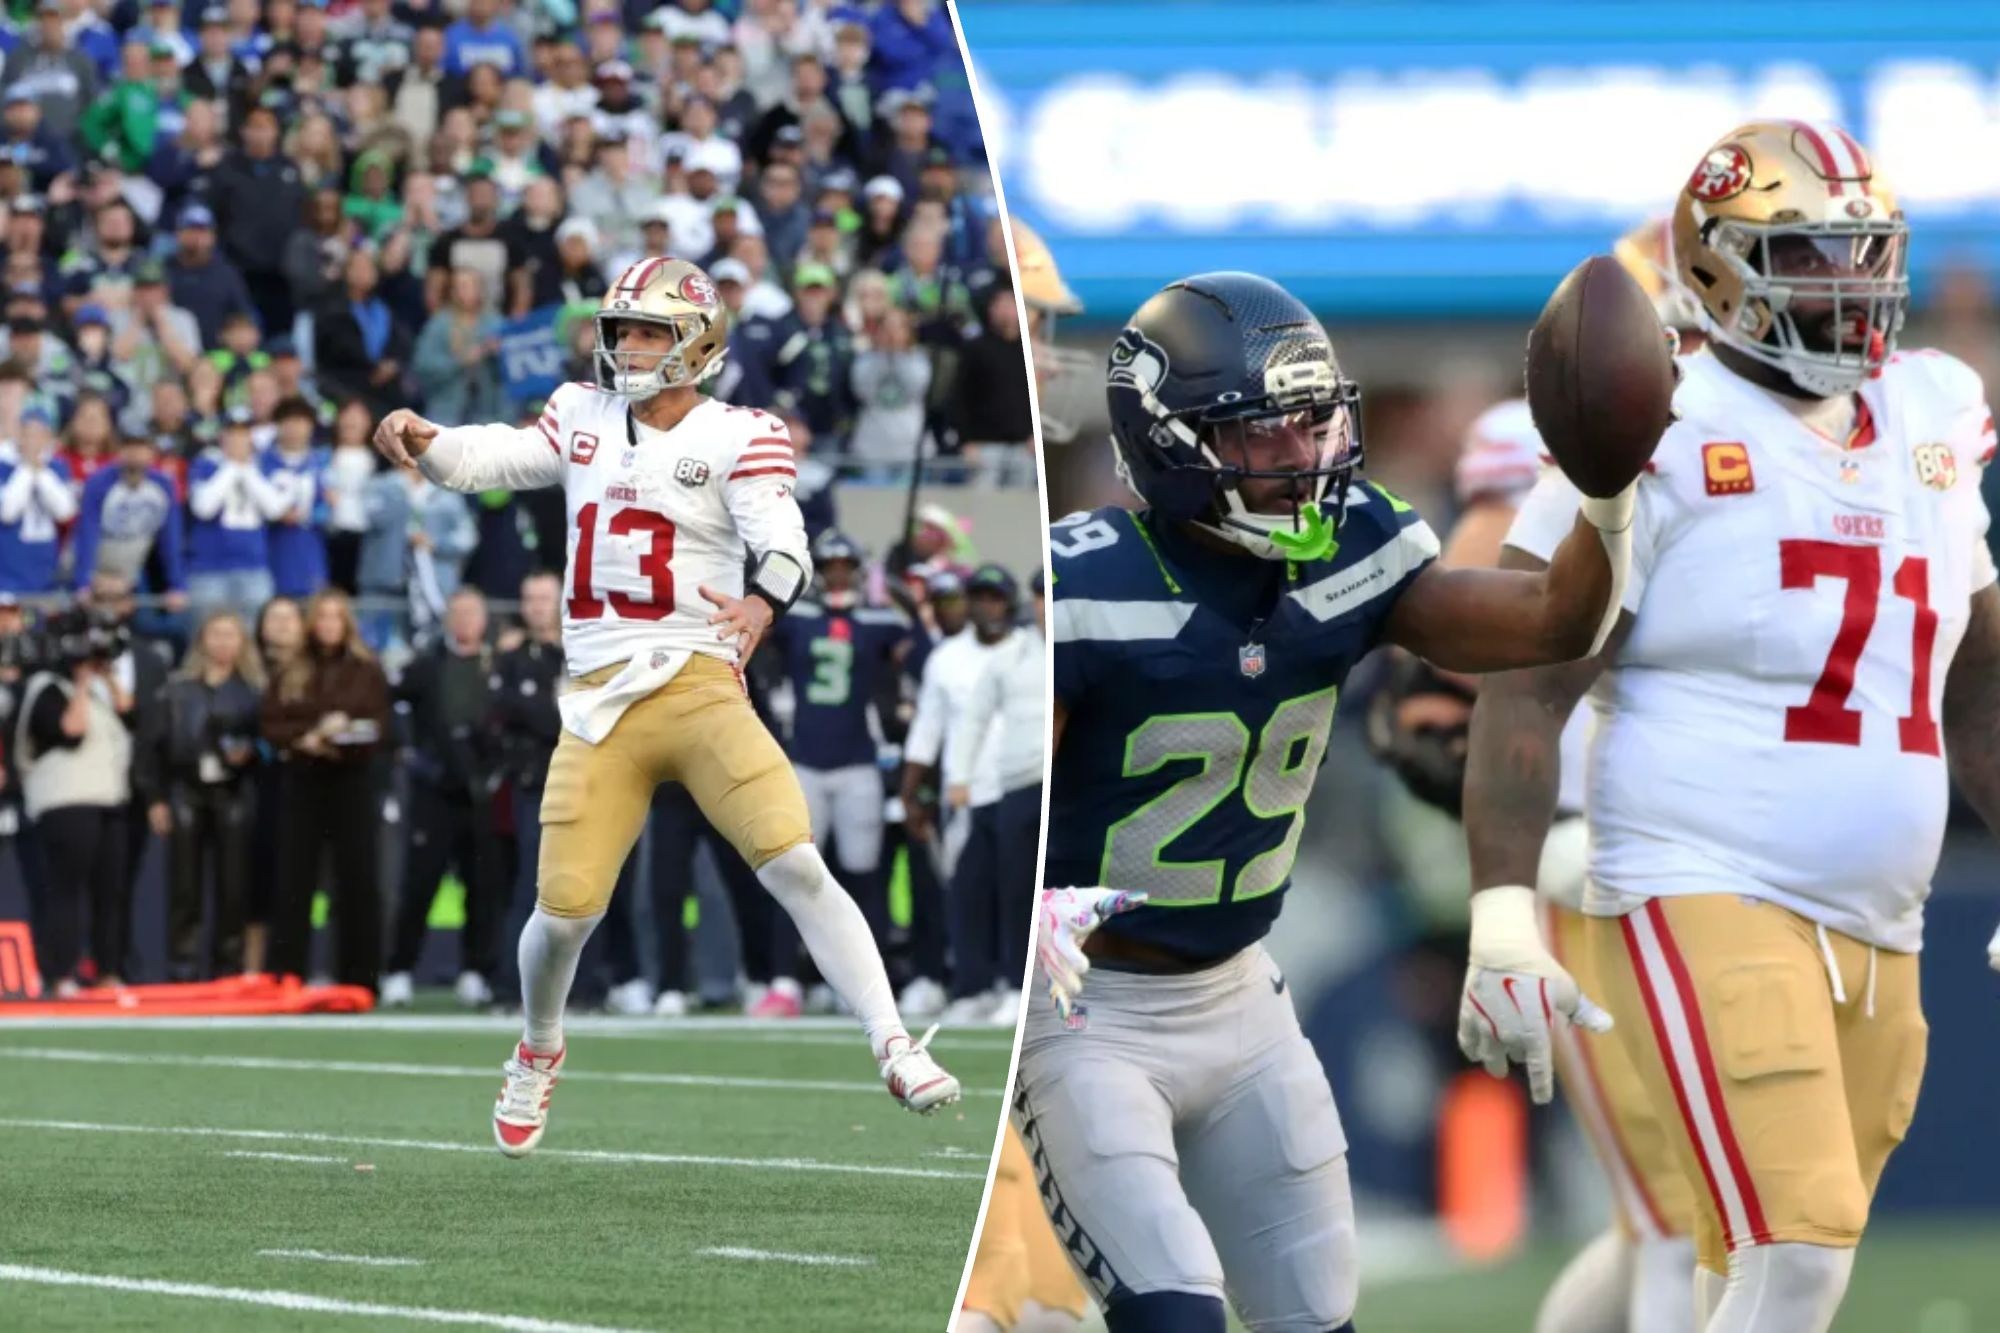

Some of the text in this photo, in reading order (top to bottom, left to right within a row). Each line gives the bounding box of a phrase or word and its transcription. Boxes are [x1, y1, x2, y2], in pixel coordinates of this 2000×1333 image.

[573, 433, 598, 457] C
[1706, 444, 1750, 483] C
[567, 502, 676, 620] 13
[807, 636, 854, 706] 3
[1779, 539, 1941, 758] 71
[1098, 684, 1338, 907] 29
